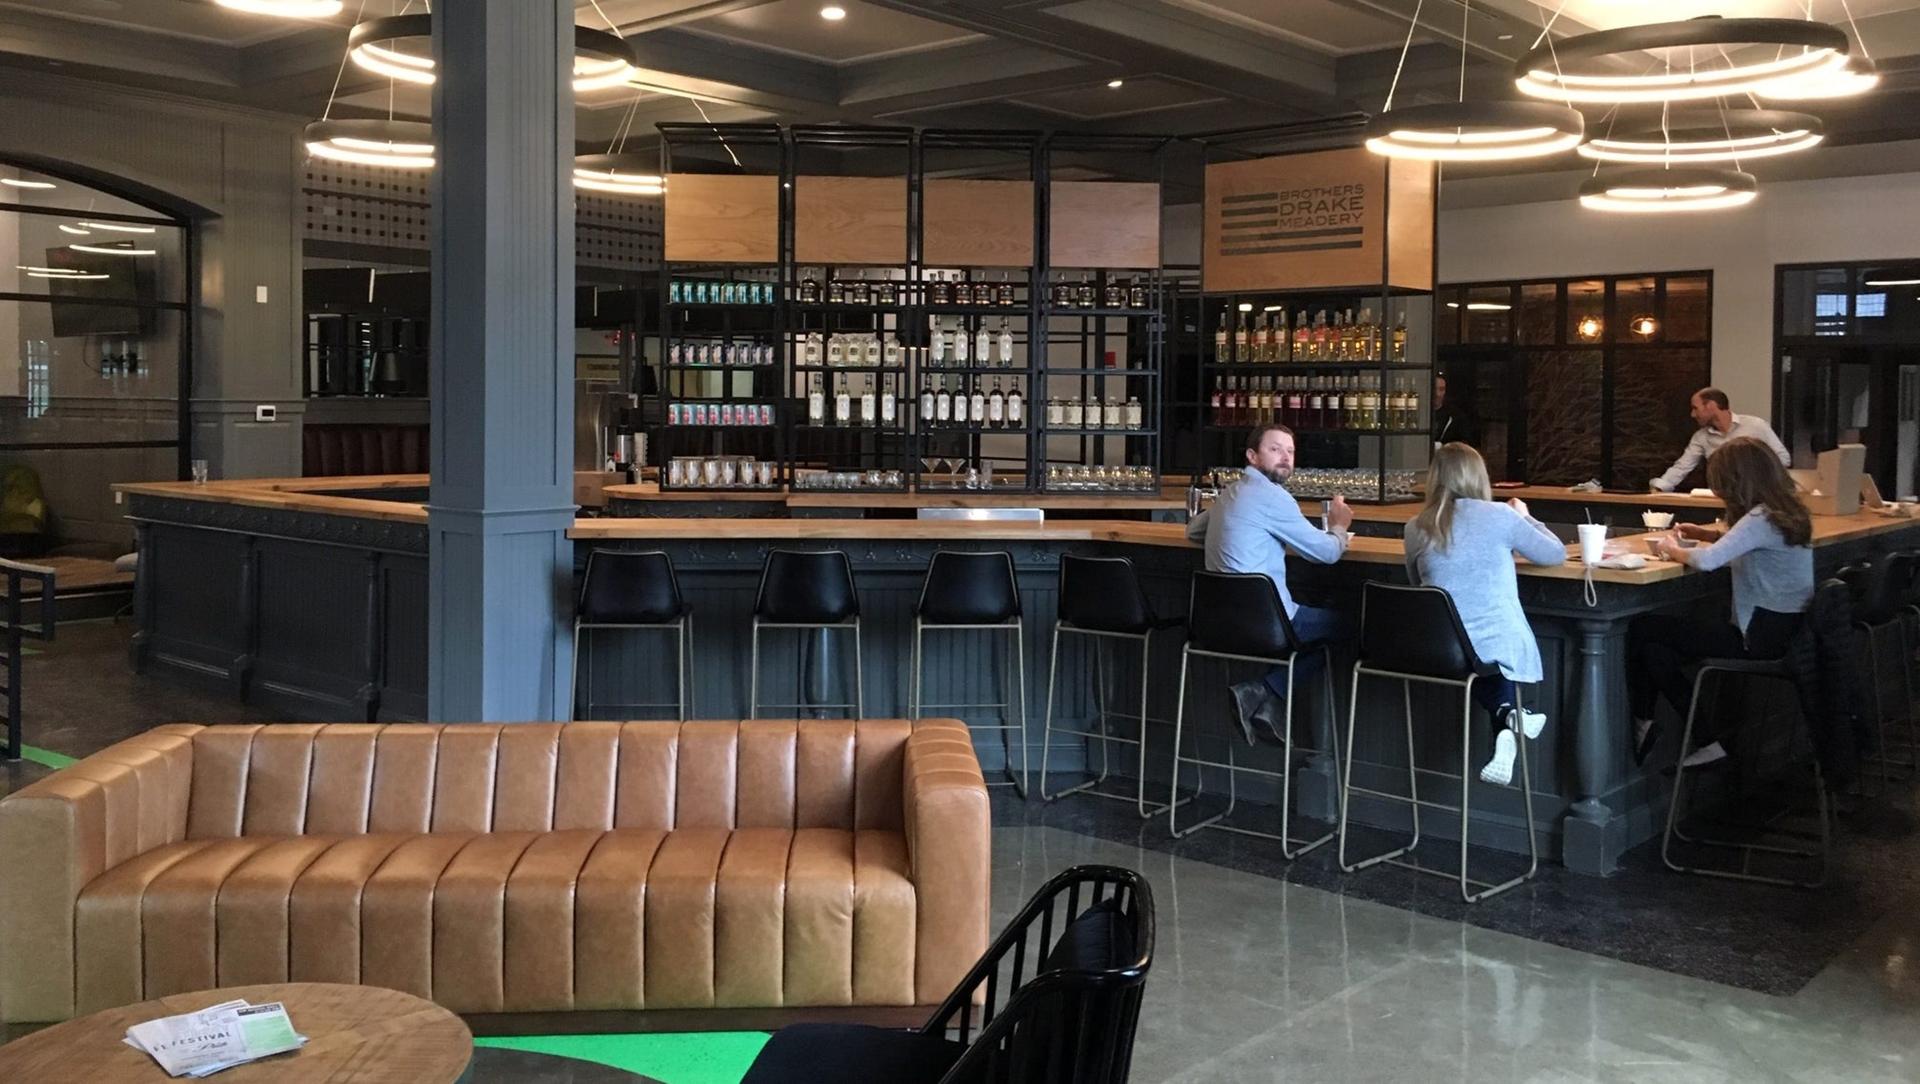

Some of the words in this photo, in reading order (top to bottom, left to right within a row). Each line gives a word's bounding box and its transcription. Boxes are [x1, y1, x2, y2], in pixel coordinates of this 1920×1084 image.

[1280, 183, 1364, 201] BROTHERS
[1280, 195, 1364, 216] DRAKE
[1280, 212, 1363, 229] MEADERY
[171, 1031, 232, 1046] FESTIVAL
